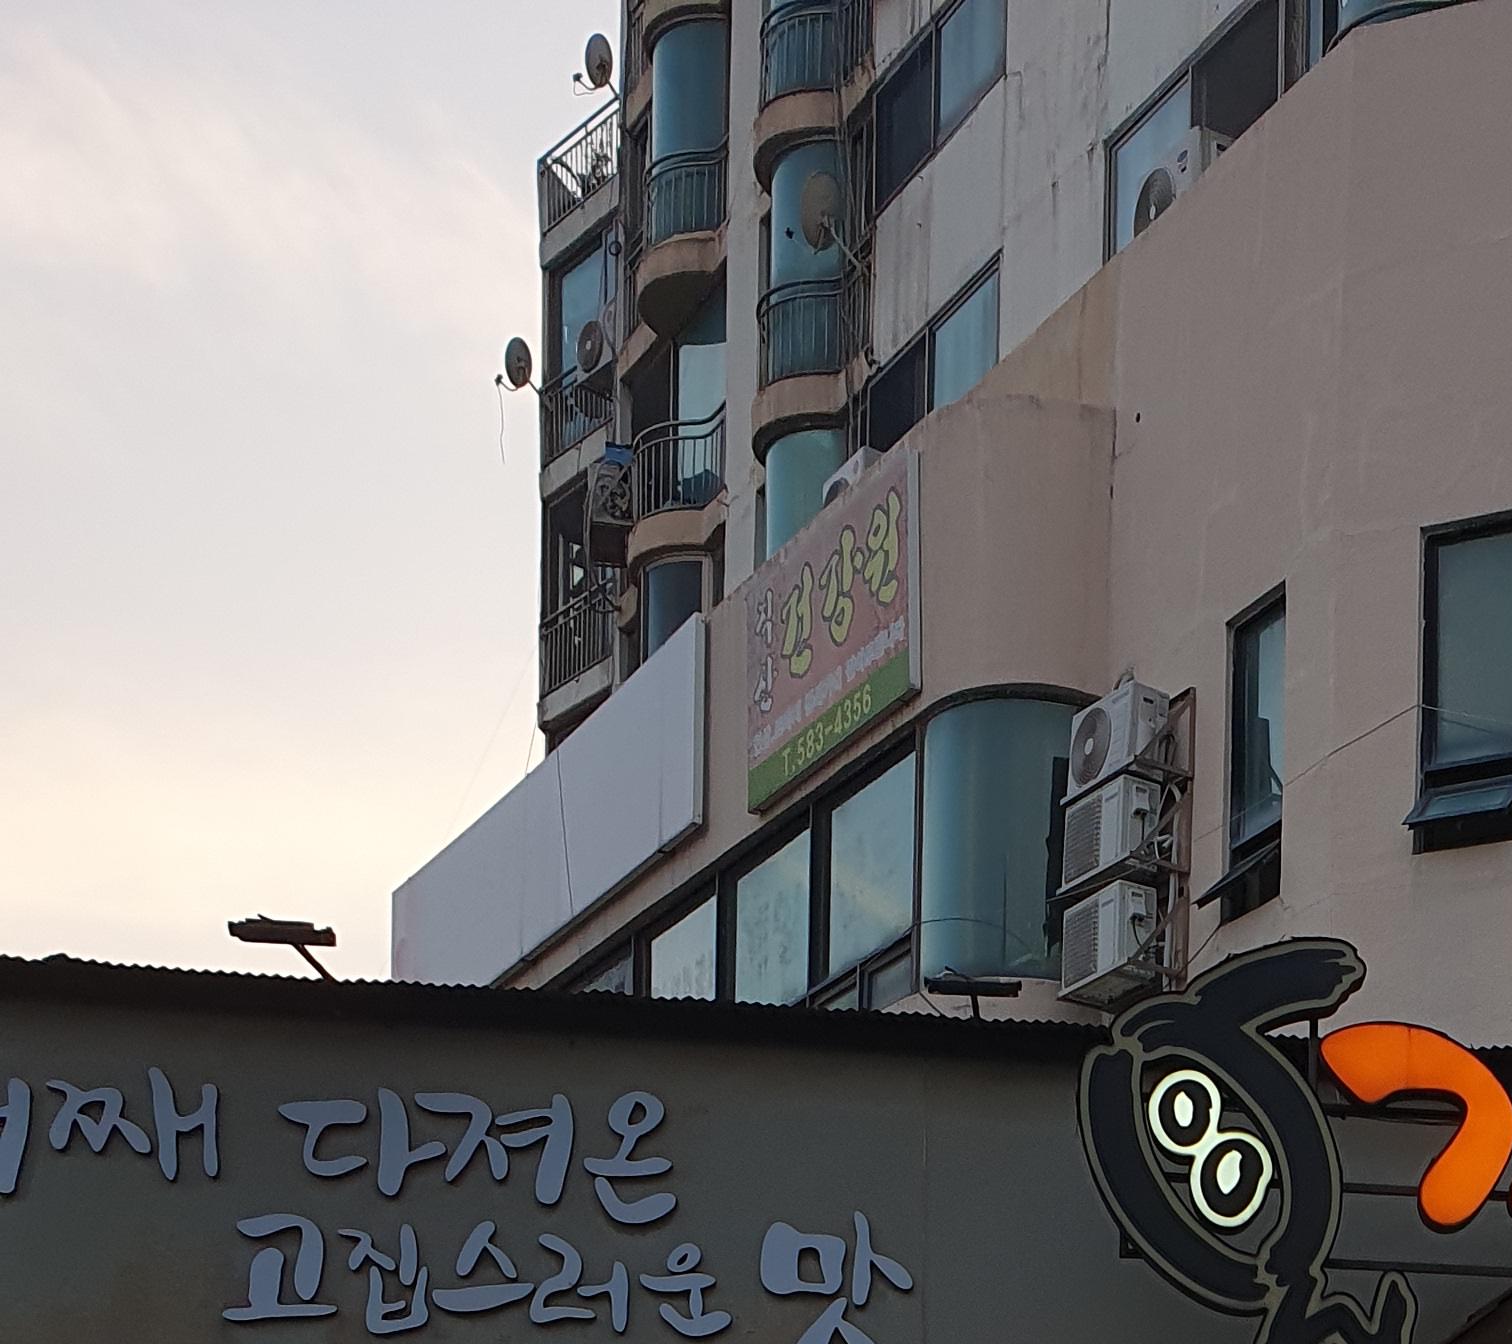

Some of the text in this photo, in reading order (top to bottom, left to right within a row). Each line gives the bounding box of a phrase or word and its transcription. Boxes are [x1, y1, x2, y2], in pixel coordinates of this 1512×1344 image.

[782, 486, 901, 679] 건강원
[278, 1087, 677, 1224] 다져온
[221, 1212, 733, 1338] 고집스러운
